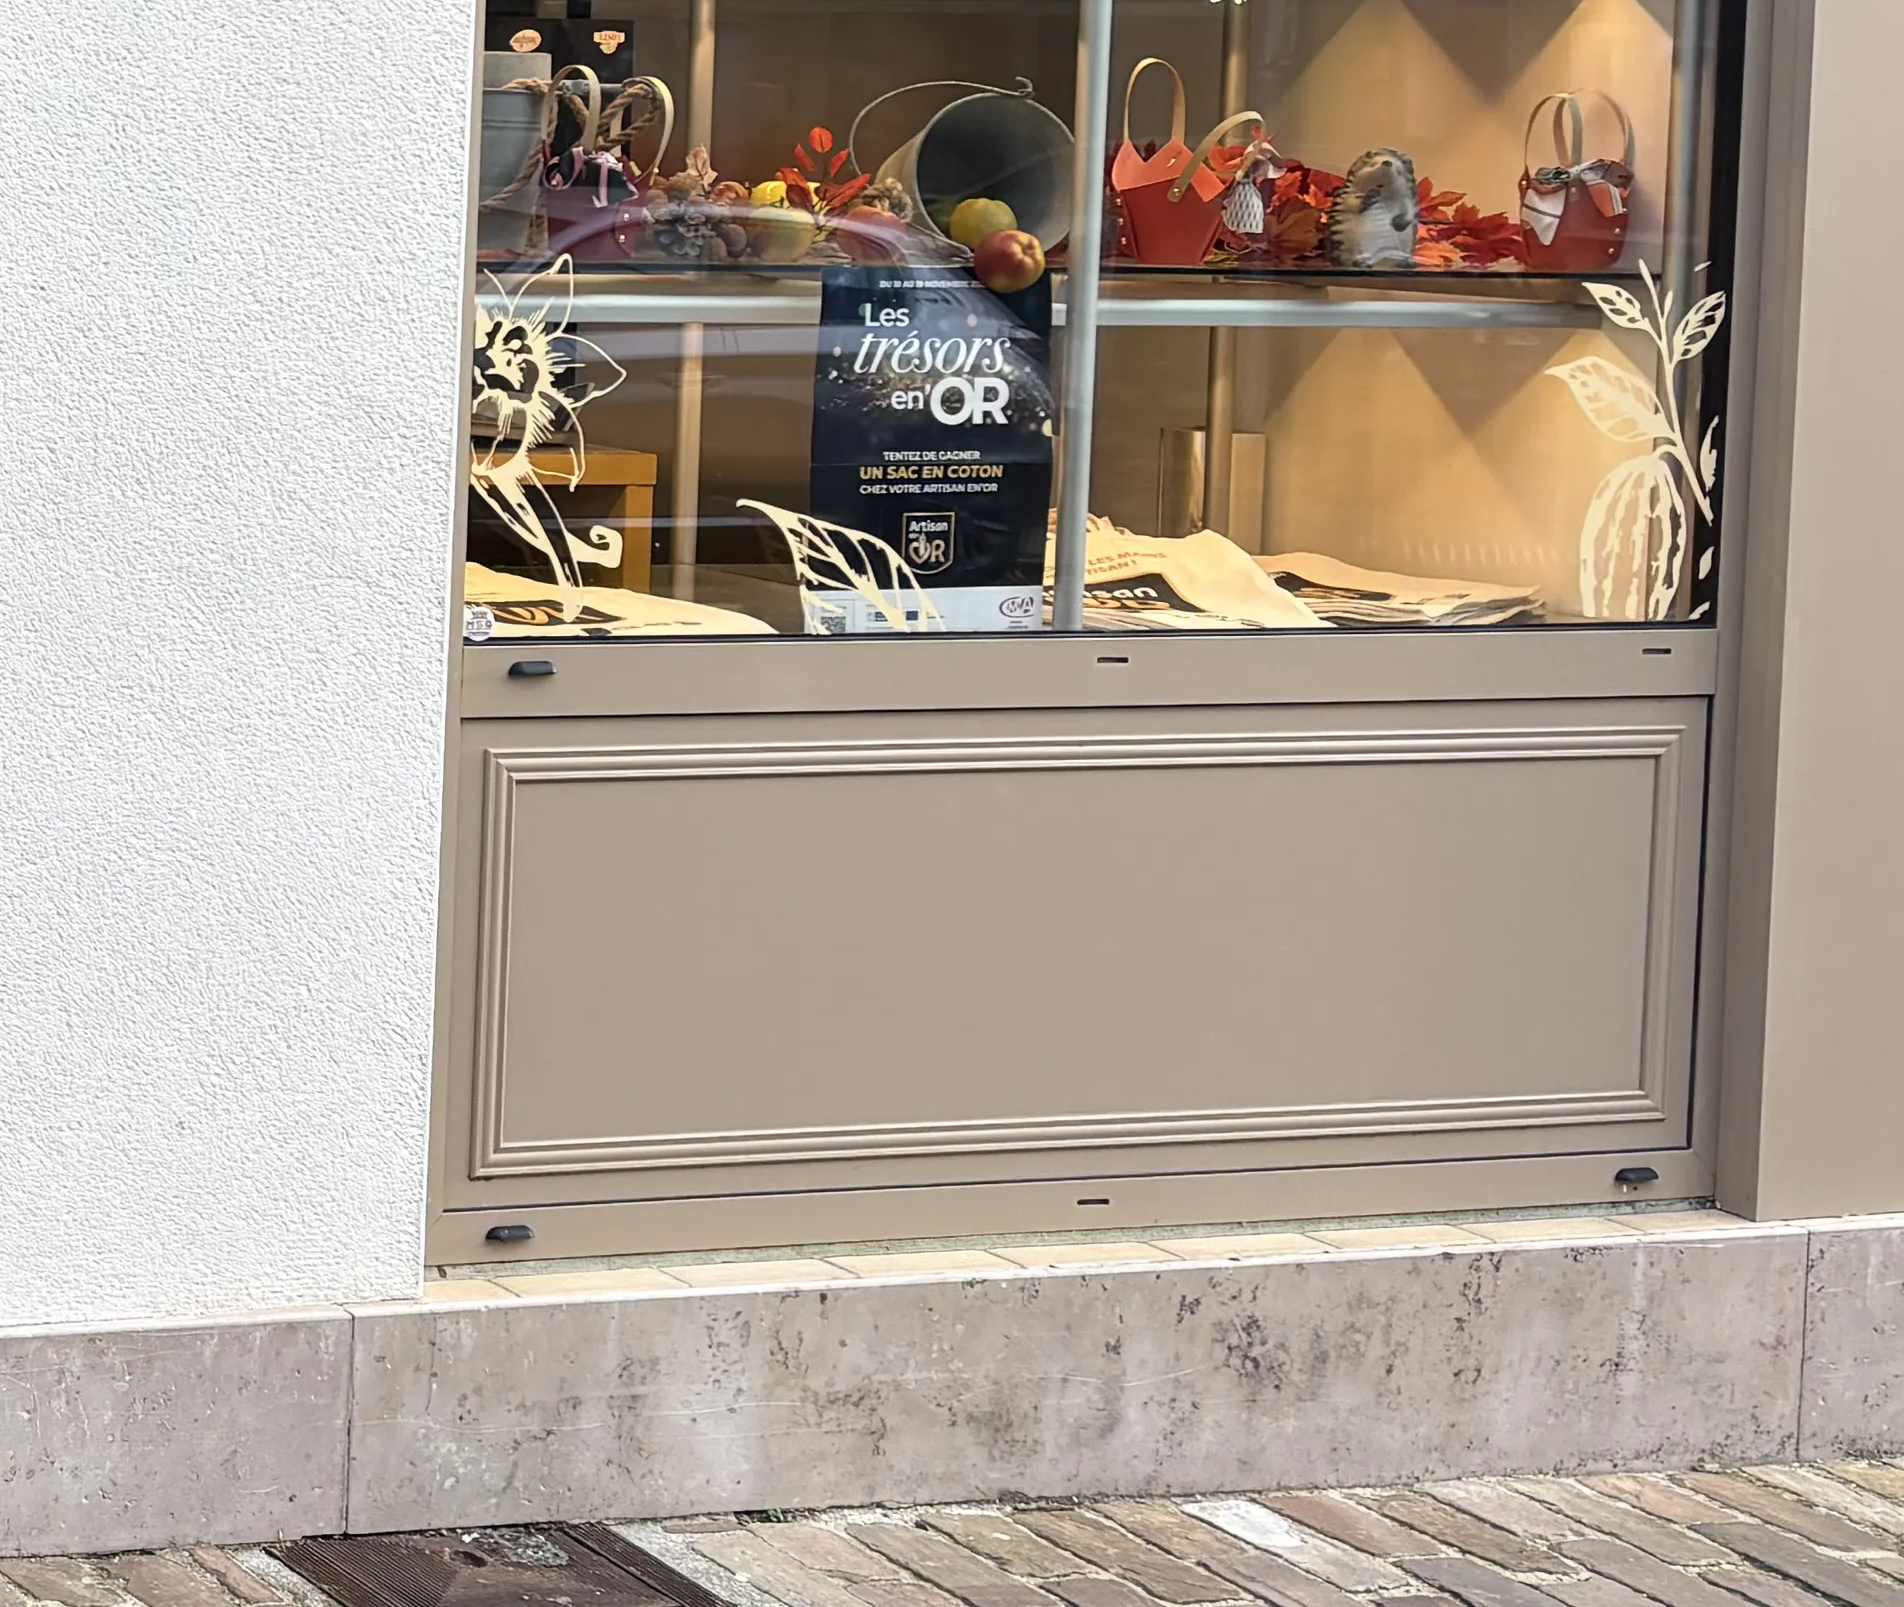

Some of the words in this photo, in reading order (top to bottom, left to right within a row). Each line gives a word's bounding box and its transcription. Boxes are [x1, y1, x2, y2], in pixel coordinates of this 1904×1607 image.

[864, 302, 910, 327] Les
[853, 330, 1011, 374] trésors
[891, 376, 1010, 425] en'OR
[882, 450, 922, 461] TENTEZ
[923, 450, 938, 461] DE
[938, 449, 981, 461] GAGNER
[859, 466, 884, 480] UN
[886, 466, 920, 480] SAC
[922, 465, 944, 479] EN
[946, 464, 1004, 478] COTON
[859, 484, 890, 495] CHEZ
[889, 484, 922, 494] VOTRE
[922, 483, 966, 494] ARTISAN
[967, 482, 999, 493] EN'OR
[909, 520, 949, 532] Artisan
[1088, 555, 1114, 566] LES
